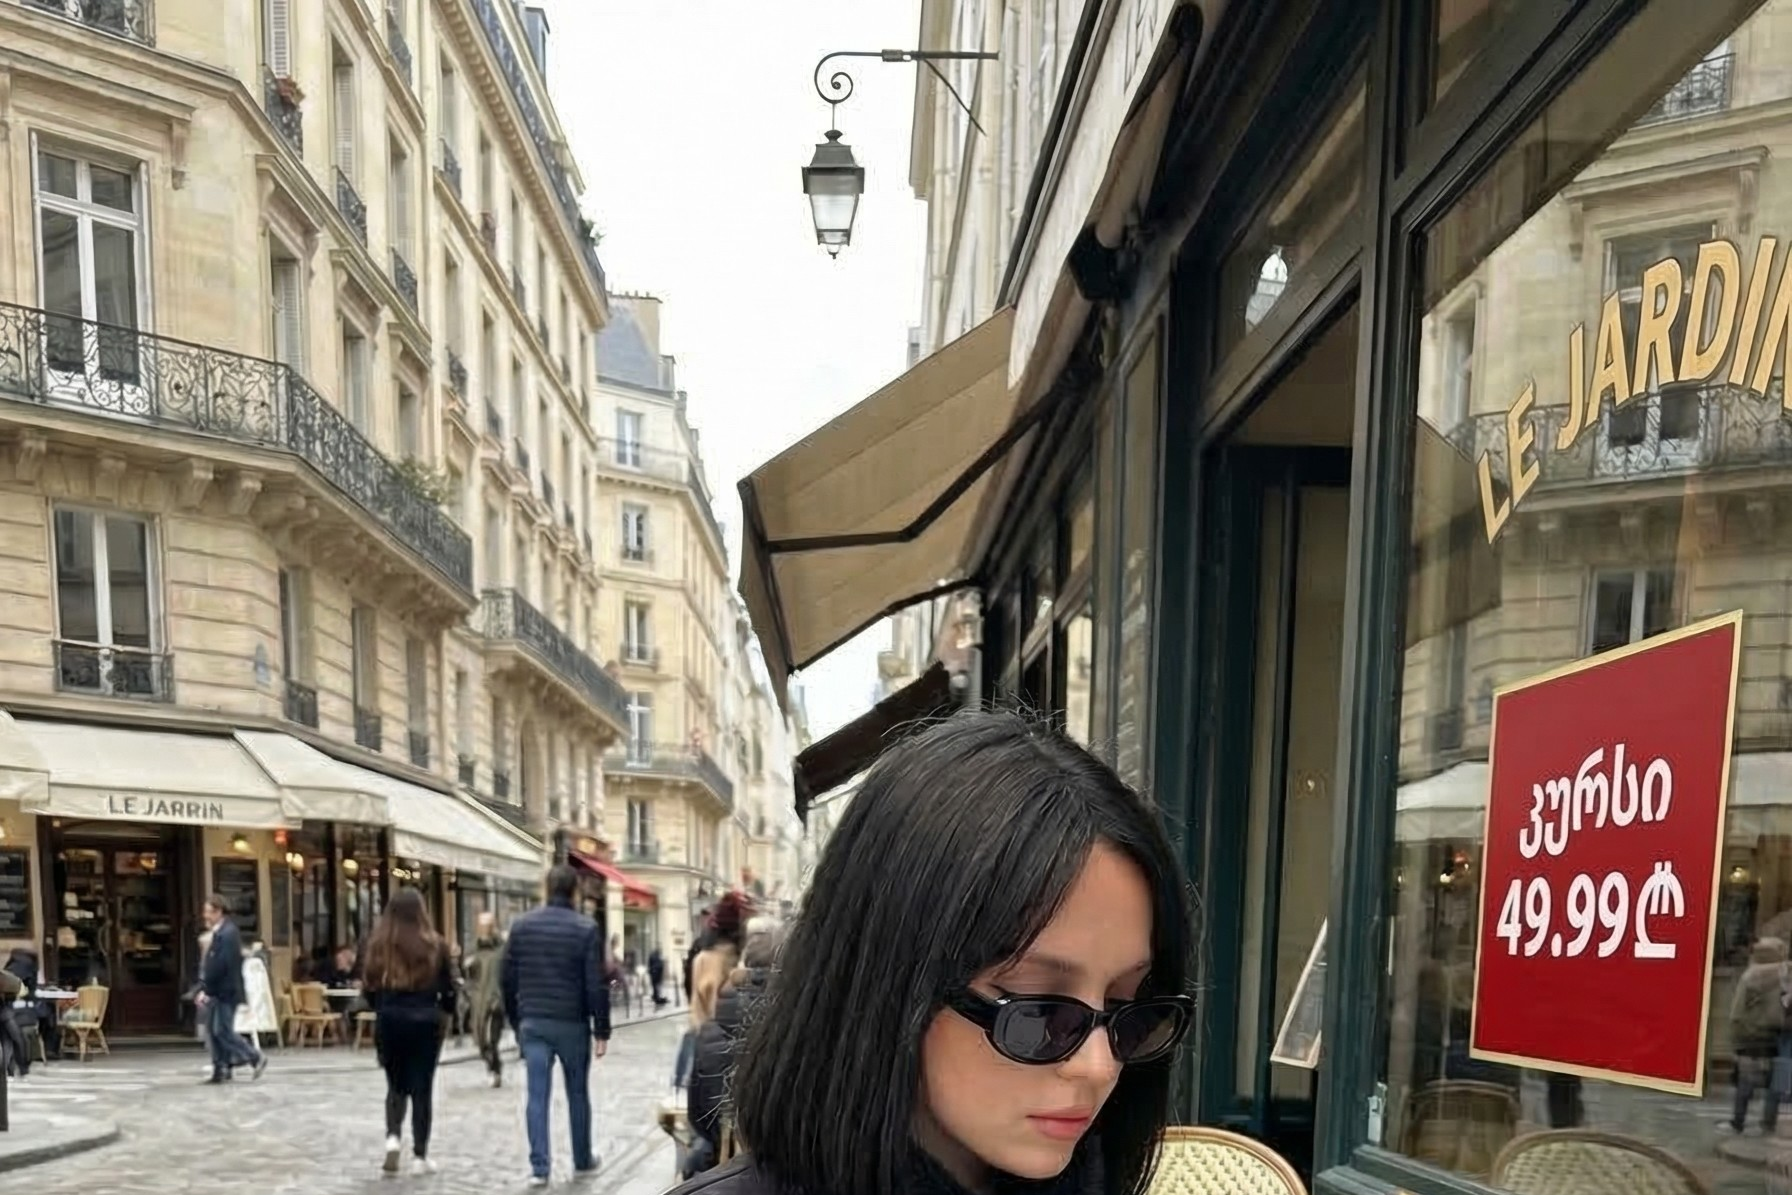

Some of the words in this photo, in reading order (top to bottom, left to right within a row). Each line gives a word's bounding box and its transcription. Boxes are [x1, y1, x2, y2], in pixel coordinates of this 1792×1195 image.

[1477, 380, 1540, 545] LE
[108, 795, 138, 815] LE
[1519, 743, 1672, 859] კურსი
[1496, 860, 1684, 958] 49.99₾
